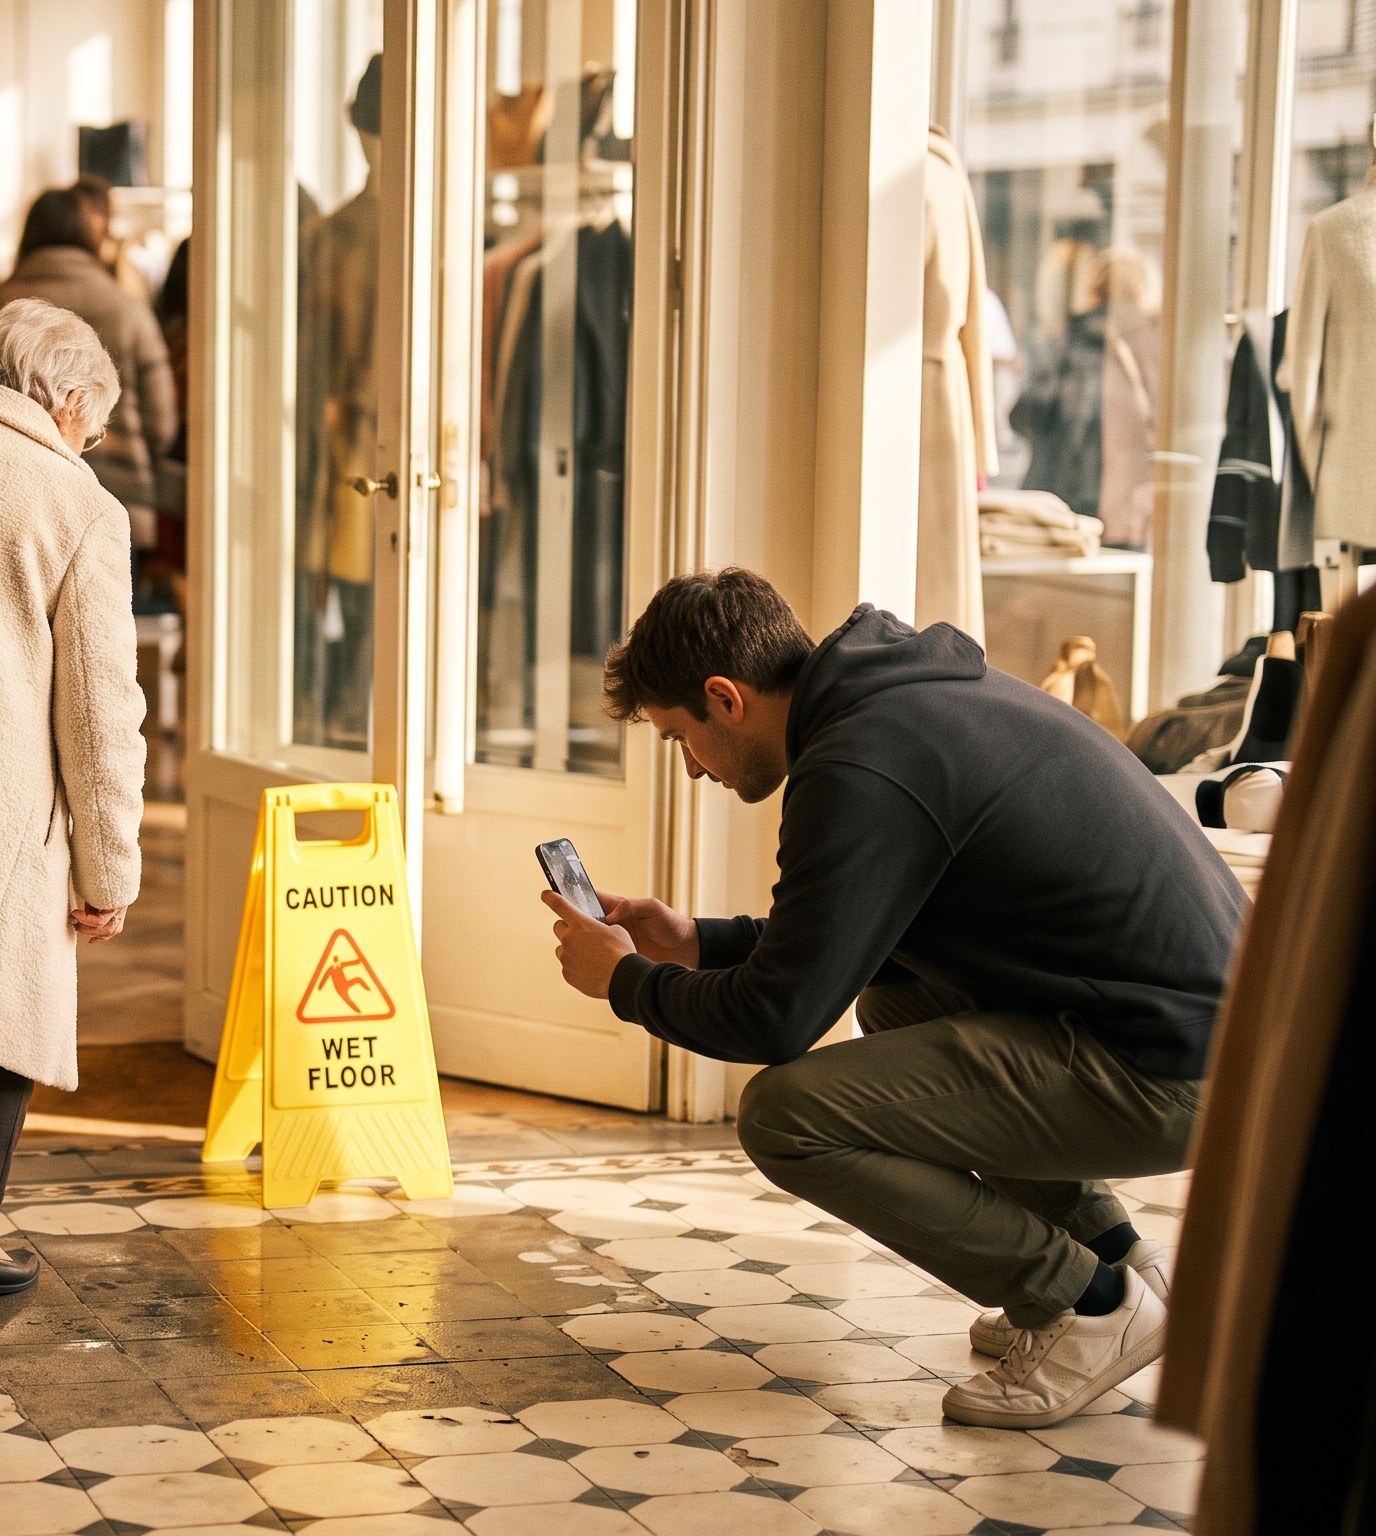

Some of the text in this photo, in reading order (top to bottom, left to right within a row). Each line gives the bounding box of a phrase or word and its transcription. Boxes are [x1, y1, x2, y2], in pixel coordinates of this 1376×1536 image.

[286, 884, 394, 910] CAUTION
[322, 1036, 378, 1060] WET
[308, 1064, 396, 1091] FLOOR
